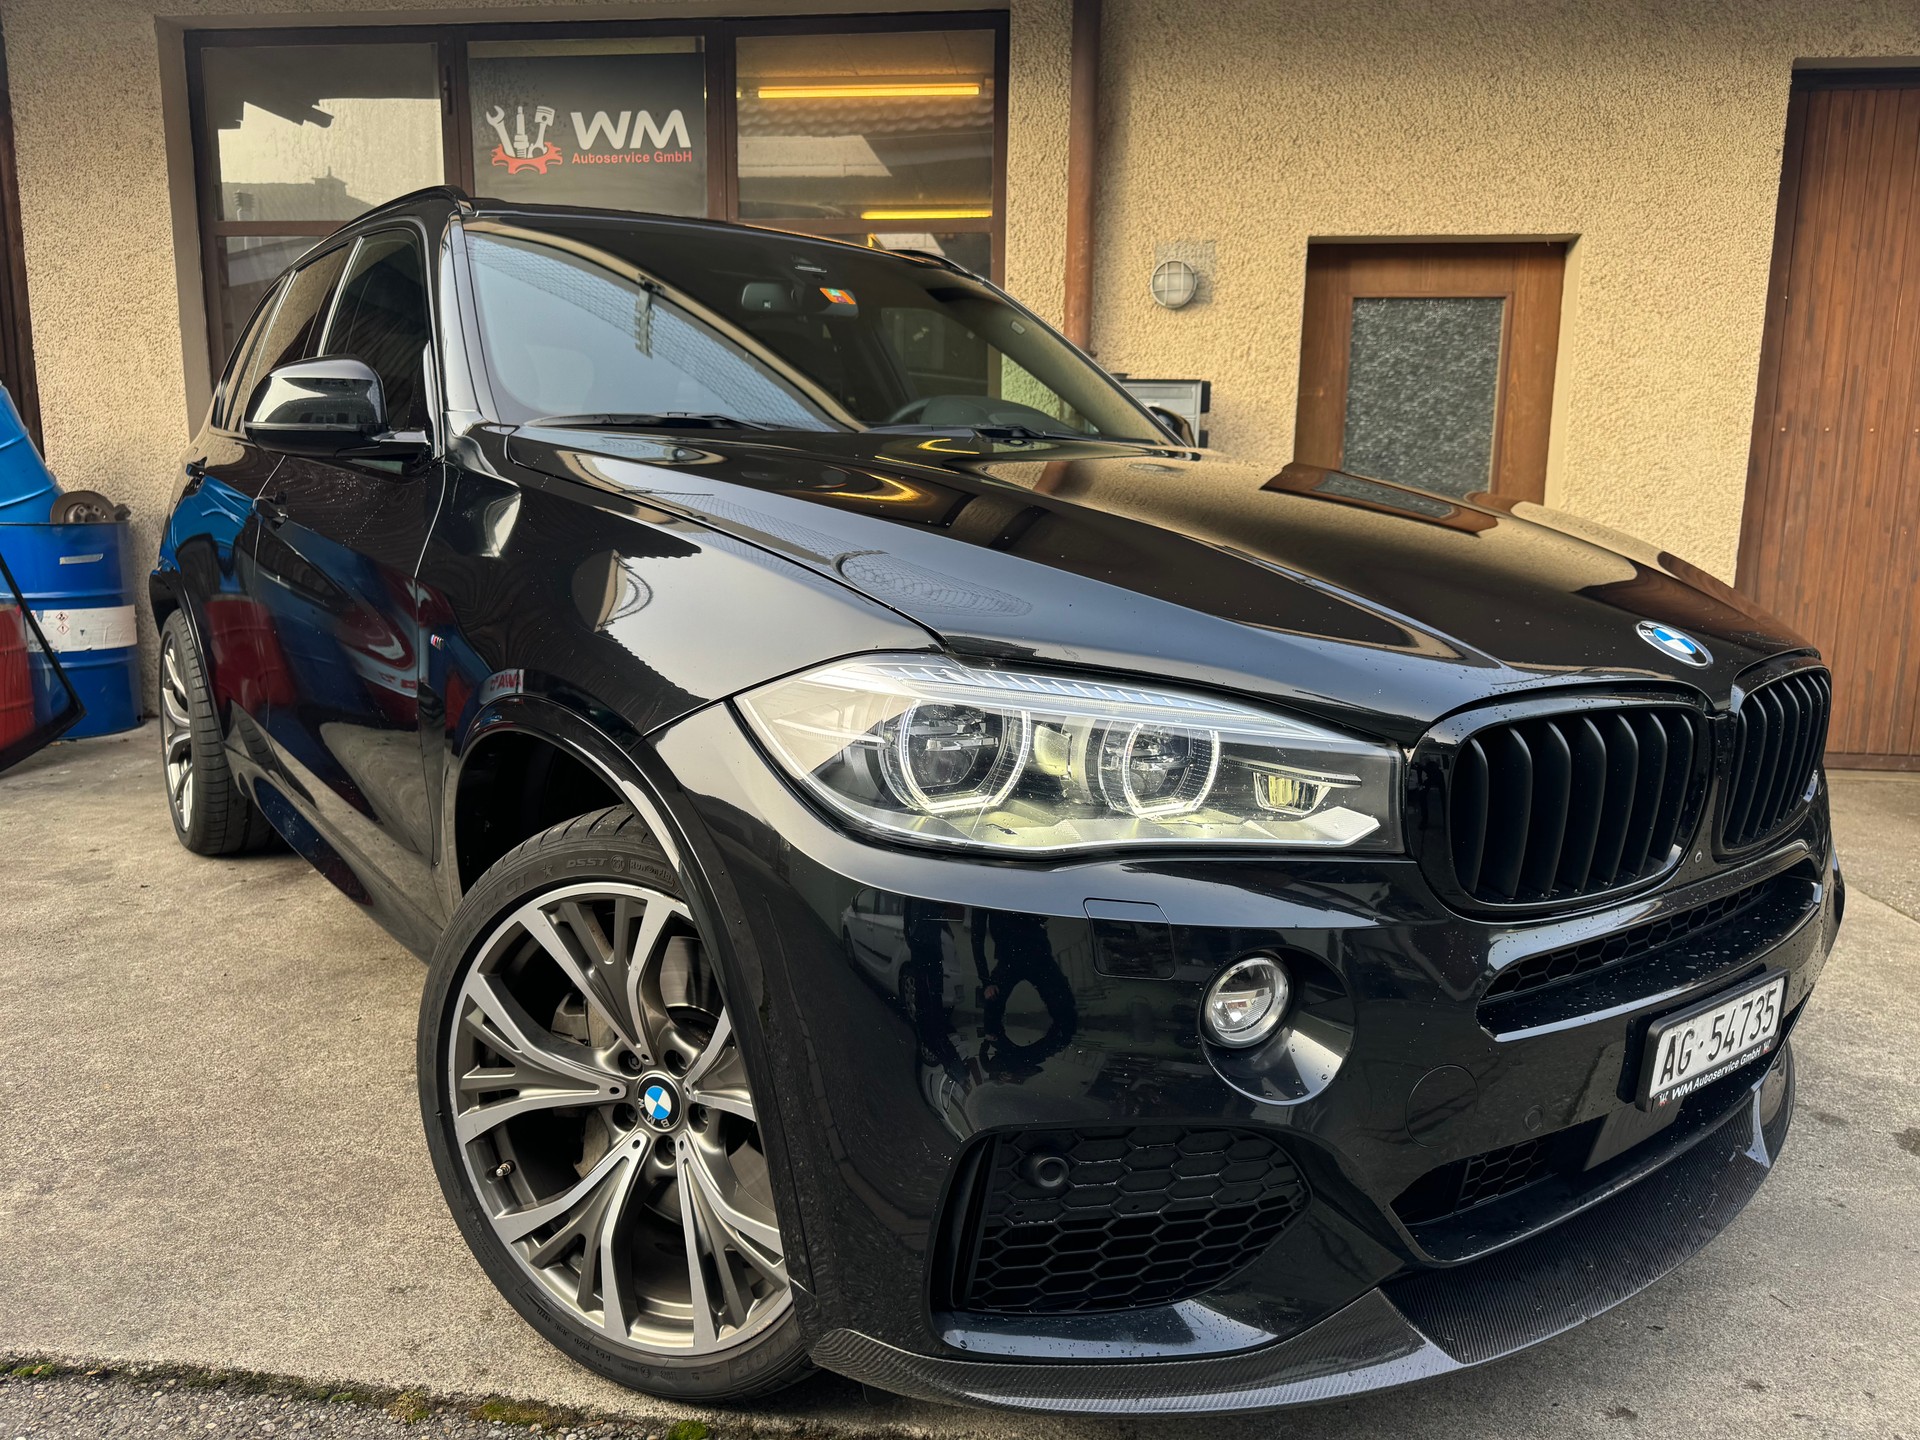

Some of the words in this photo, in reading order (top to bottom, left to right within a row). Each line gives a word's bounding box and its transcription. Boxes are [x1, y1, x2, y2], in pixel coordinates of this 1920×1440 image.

[570, 109, 692, 150] WM
[571, 152, 650, 165] Autoservice
[653, 150, 693, 163] GmbH
[1671, 1080, 1693, 1100] WM
[1693, 1059, 1740, 1089] Autoservice
[1740, 1045, 1762, 1065] GmbH
